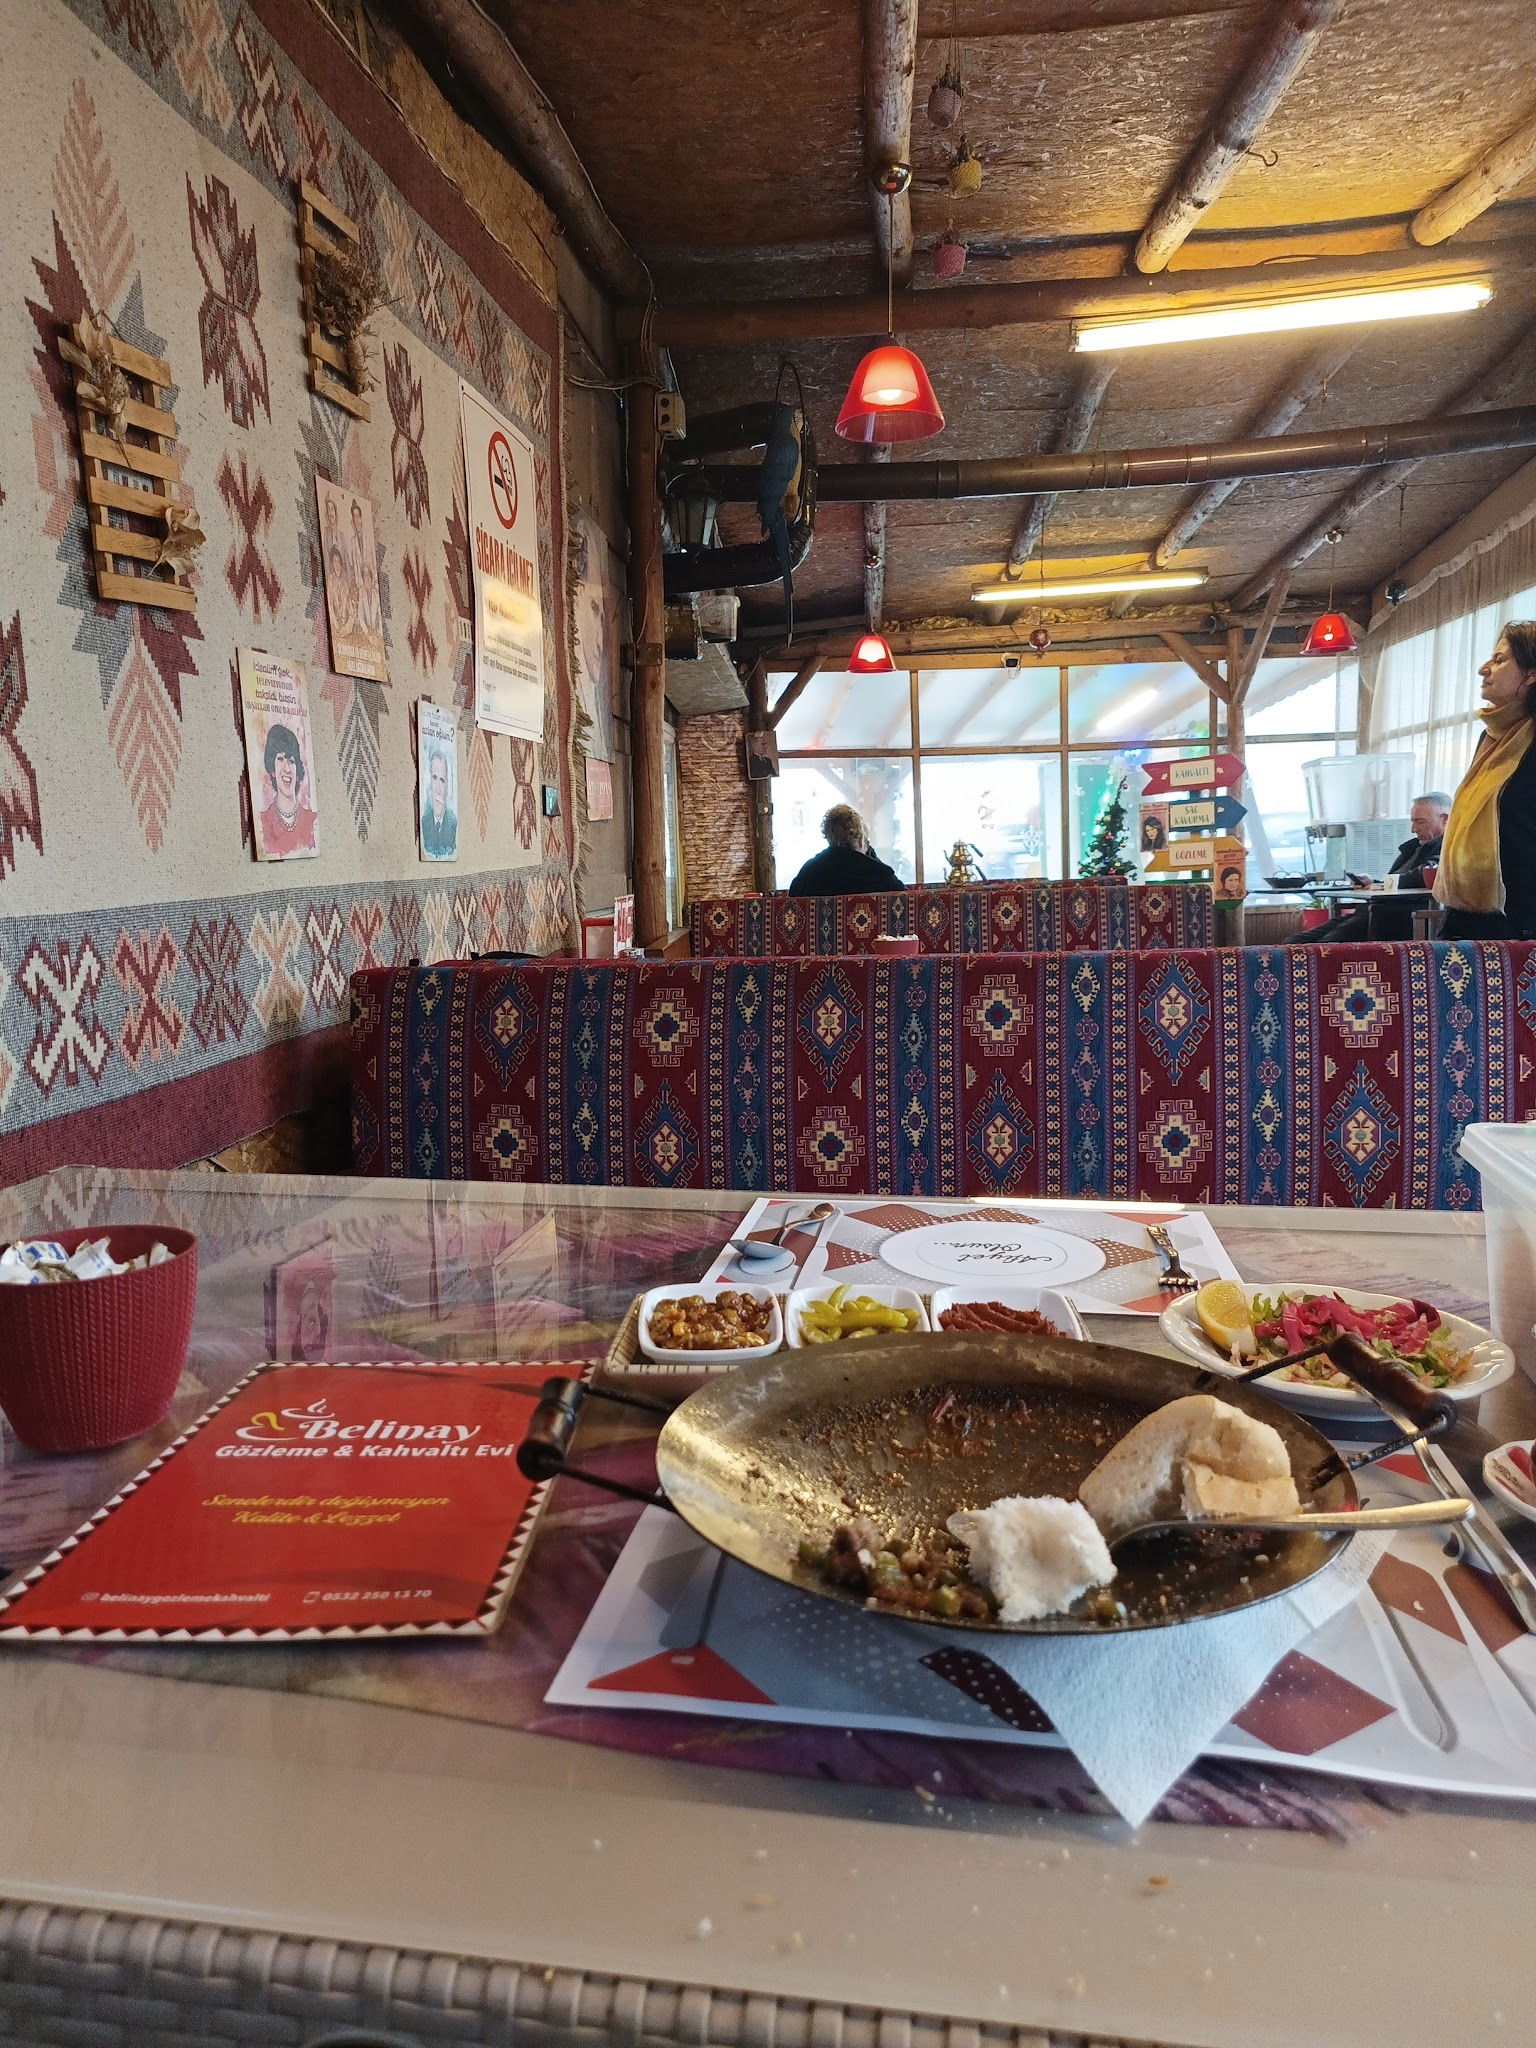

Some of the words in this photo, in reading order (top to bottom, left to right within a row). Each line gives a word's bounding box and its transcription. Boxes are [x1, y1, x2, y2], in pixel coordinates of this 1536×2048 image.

[476, 522, 506, 583] SİGARA
[506, 540, 536, 600] İÇİLMEZ
[1174, 814, 1210, 825] KAVURMA
[957, 1252, 1052, 1263] Afiyet
[299, 1419, 481, 1444] Belinay
[215, 1444, 330, 1457] Gözleme
[333, 1444, 353, 1457] &
[358, 1444, 468, 1457] Kahvaltı
[475, 1443, 516, 1457] Evi
[319, 1495, 450, 1508] değişmeyen
[232, 1511, 301, 1523] Kalite
[323, 1511, 401, 1525] Lezzet
